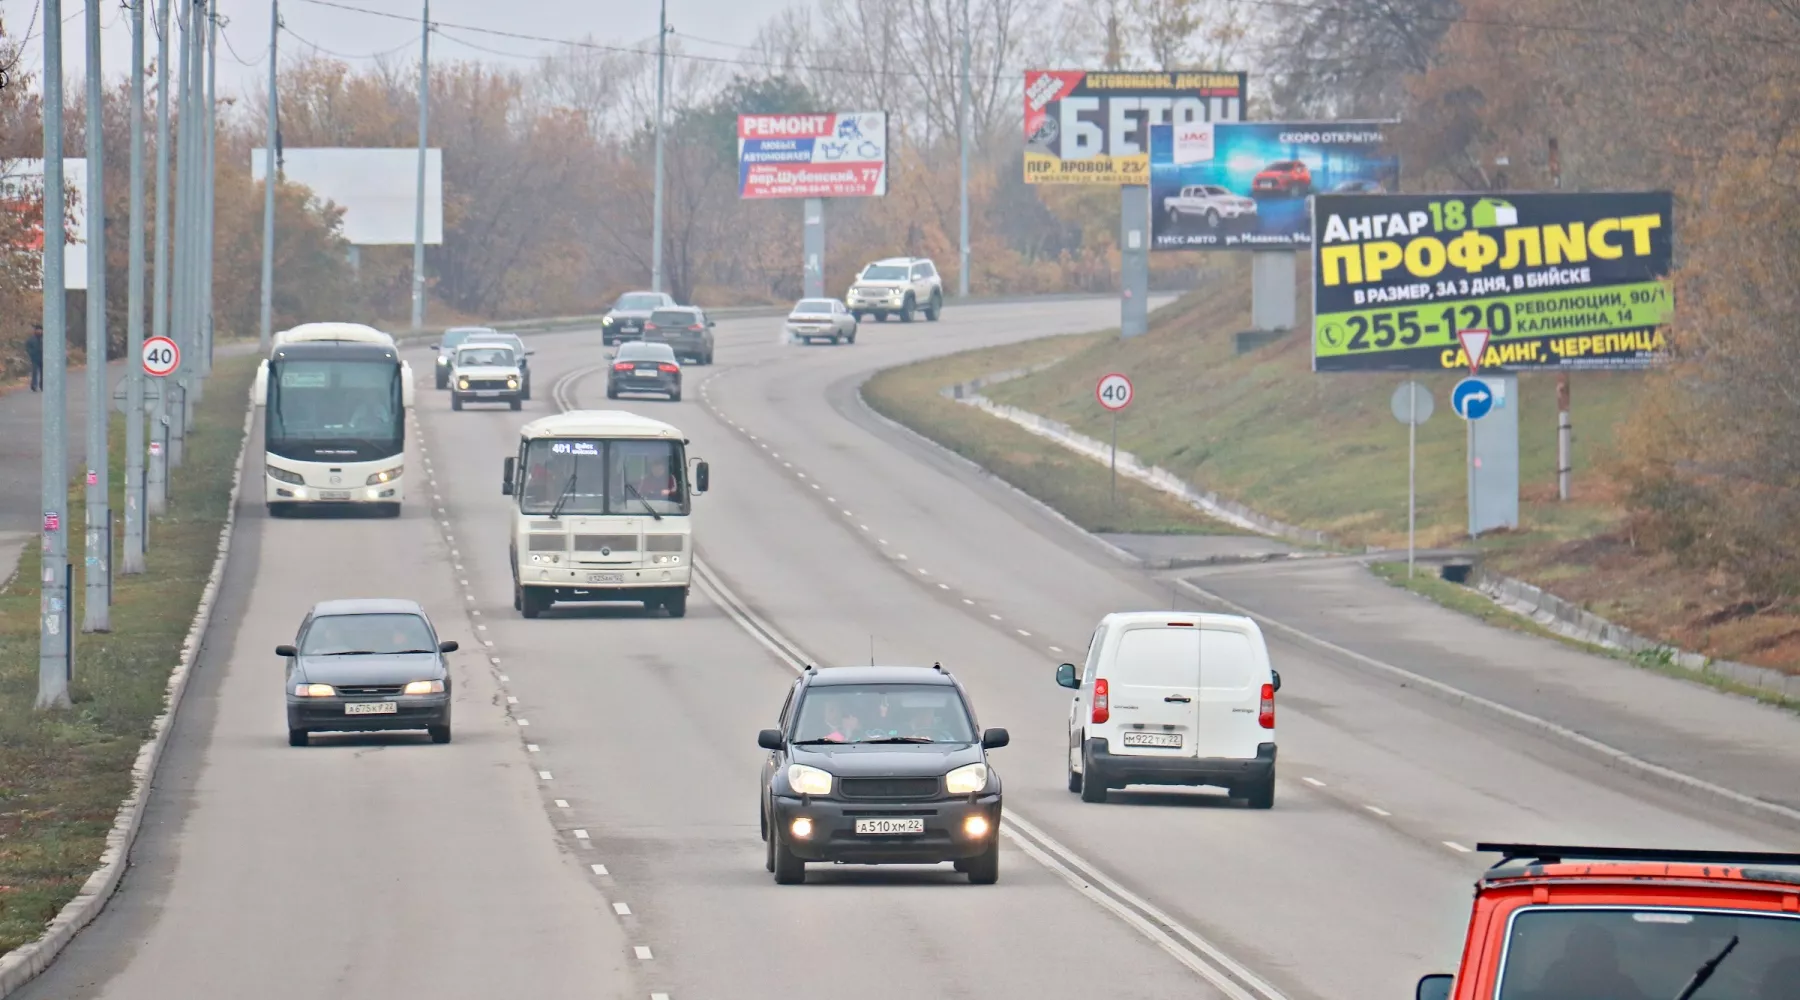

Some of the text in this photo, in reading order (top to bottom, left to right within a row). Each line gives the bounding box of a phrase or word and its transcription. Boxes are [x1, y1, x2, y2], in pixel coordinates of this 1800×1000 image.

[743, 115, 827, 135] РЕМОНТ
[1179, 132, 1209, 142] JAC
[1279, 131, 1320, 144] СКОРО
[743, 151, 811, 162] АВТОМОБИЛЕЙ
[861, 168, 879, 182] 77
[1186, 235, 1217, 244] АВТО
[1354, 266, 1591, 305] В РАЗМЕР, ЗА 3 ДНЯ, В БИЙСКЕ
[1515, 292, 1627, 316] РЕВОЛЮЦИИ,
[1345, 302, 1513, 350] 255-120
[1517, 309, 1633, 333] КАЛИНИНА, 14
[147, 348, 172, 364] 40
[1441, 341, 1548, 368] САДИНГ,
[1550, 329, 1666, 357] ЧЕРЕПИЦА
[1102, 384, 1127, 401] 40
[552, 443, 571, 454] 401
